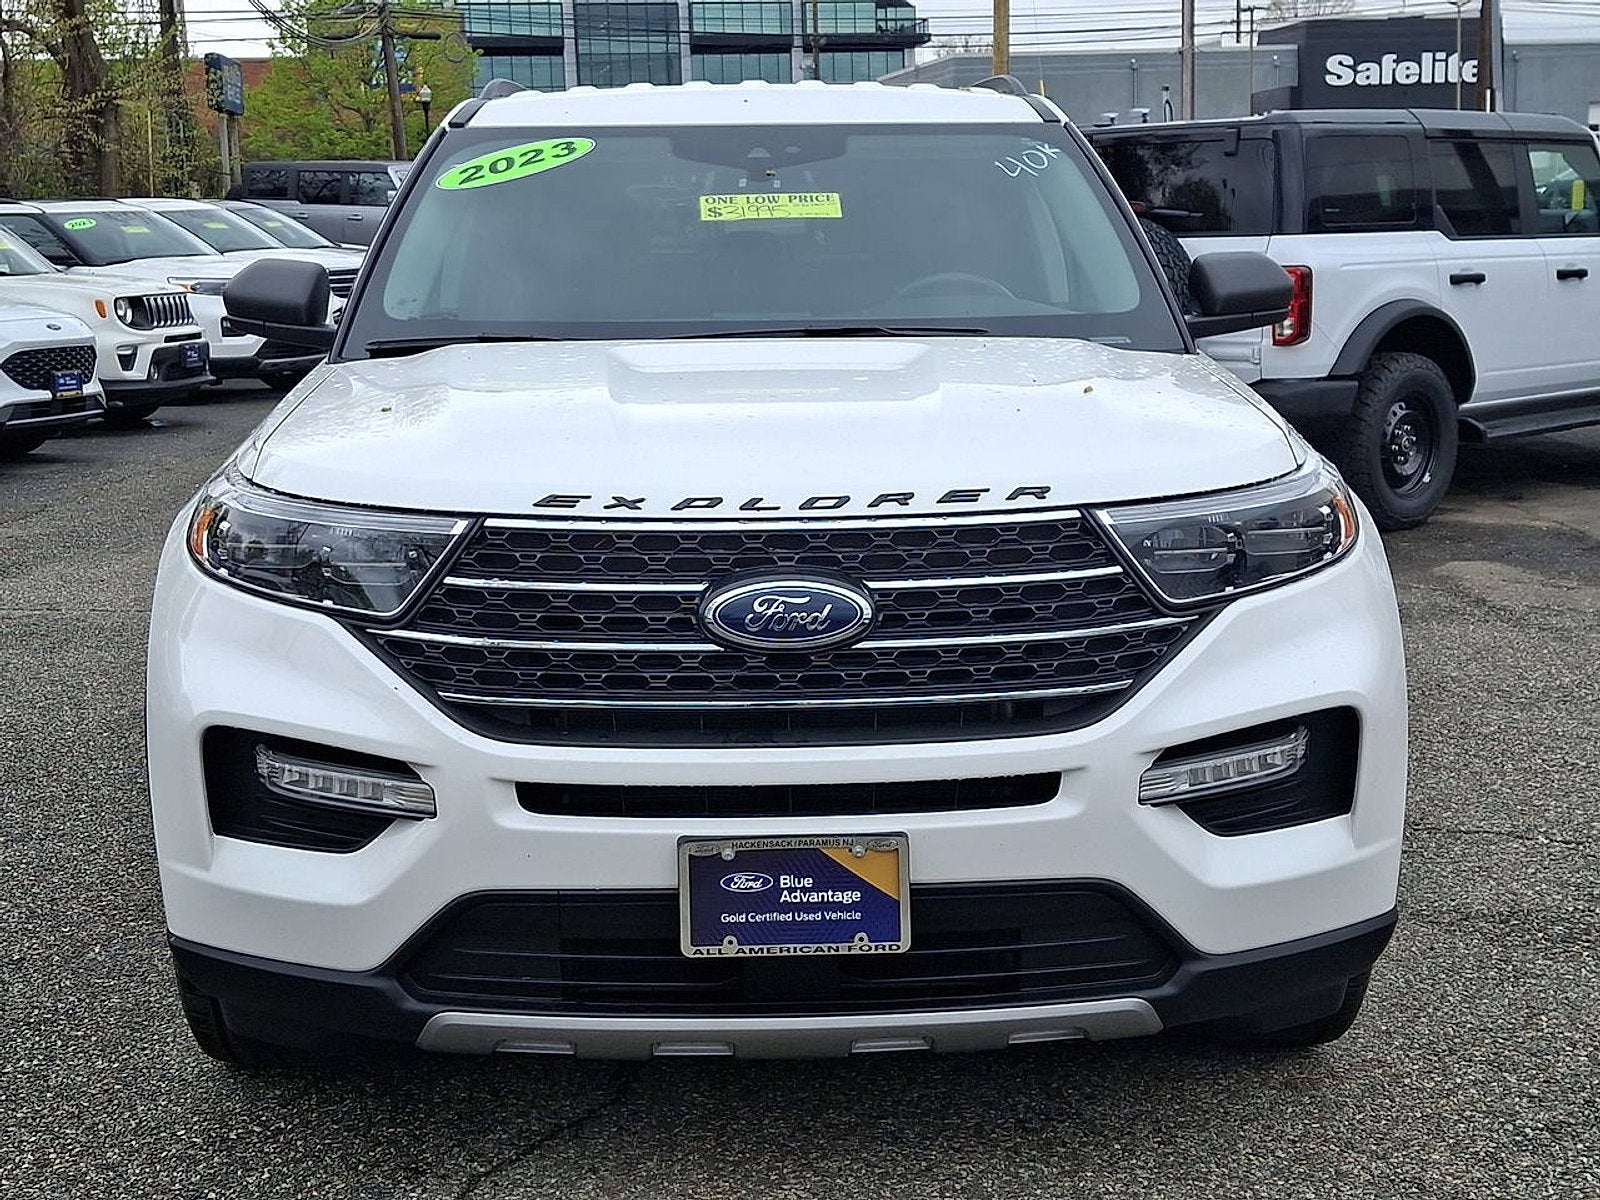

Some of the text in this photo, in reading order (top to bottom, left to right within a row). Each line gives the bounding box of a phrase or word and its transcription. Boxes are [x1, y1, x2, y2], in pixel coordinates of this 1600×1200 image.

[458, 141, 577, 186] 2023
[704, 194, 836, 205] ONE LOW PRICE
[533, 486, 1052, 511] EXPLORER
[744, 595, 833, 632] Ford
[842, 838, 855, 847] NJ
[730, 875, 764, 889] Ford
[779, 875, 813, 888] Blue
[779, 889, 861, 905] Advantage
[720, 910, 862, 923] Gold Certified Used Vehicle
[692, 943, 901, 956] ALL AMERICAN FORD
